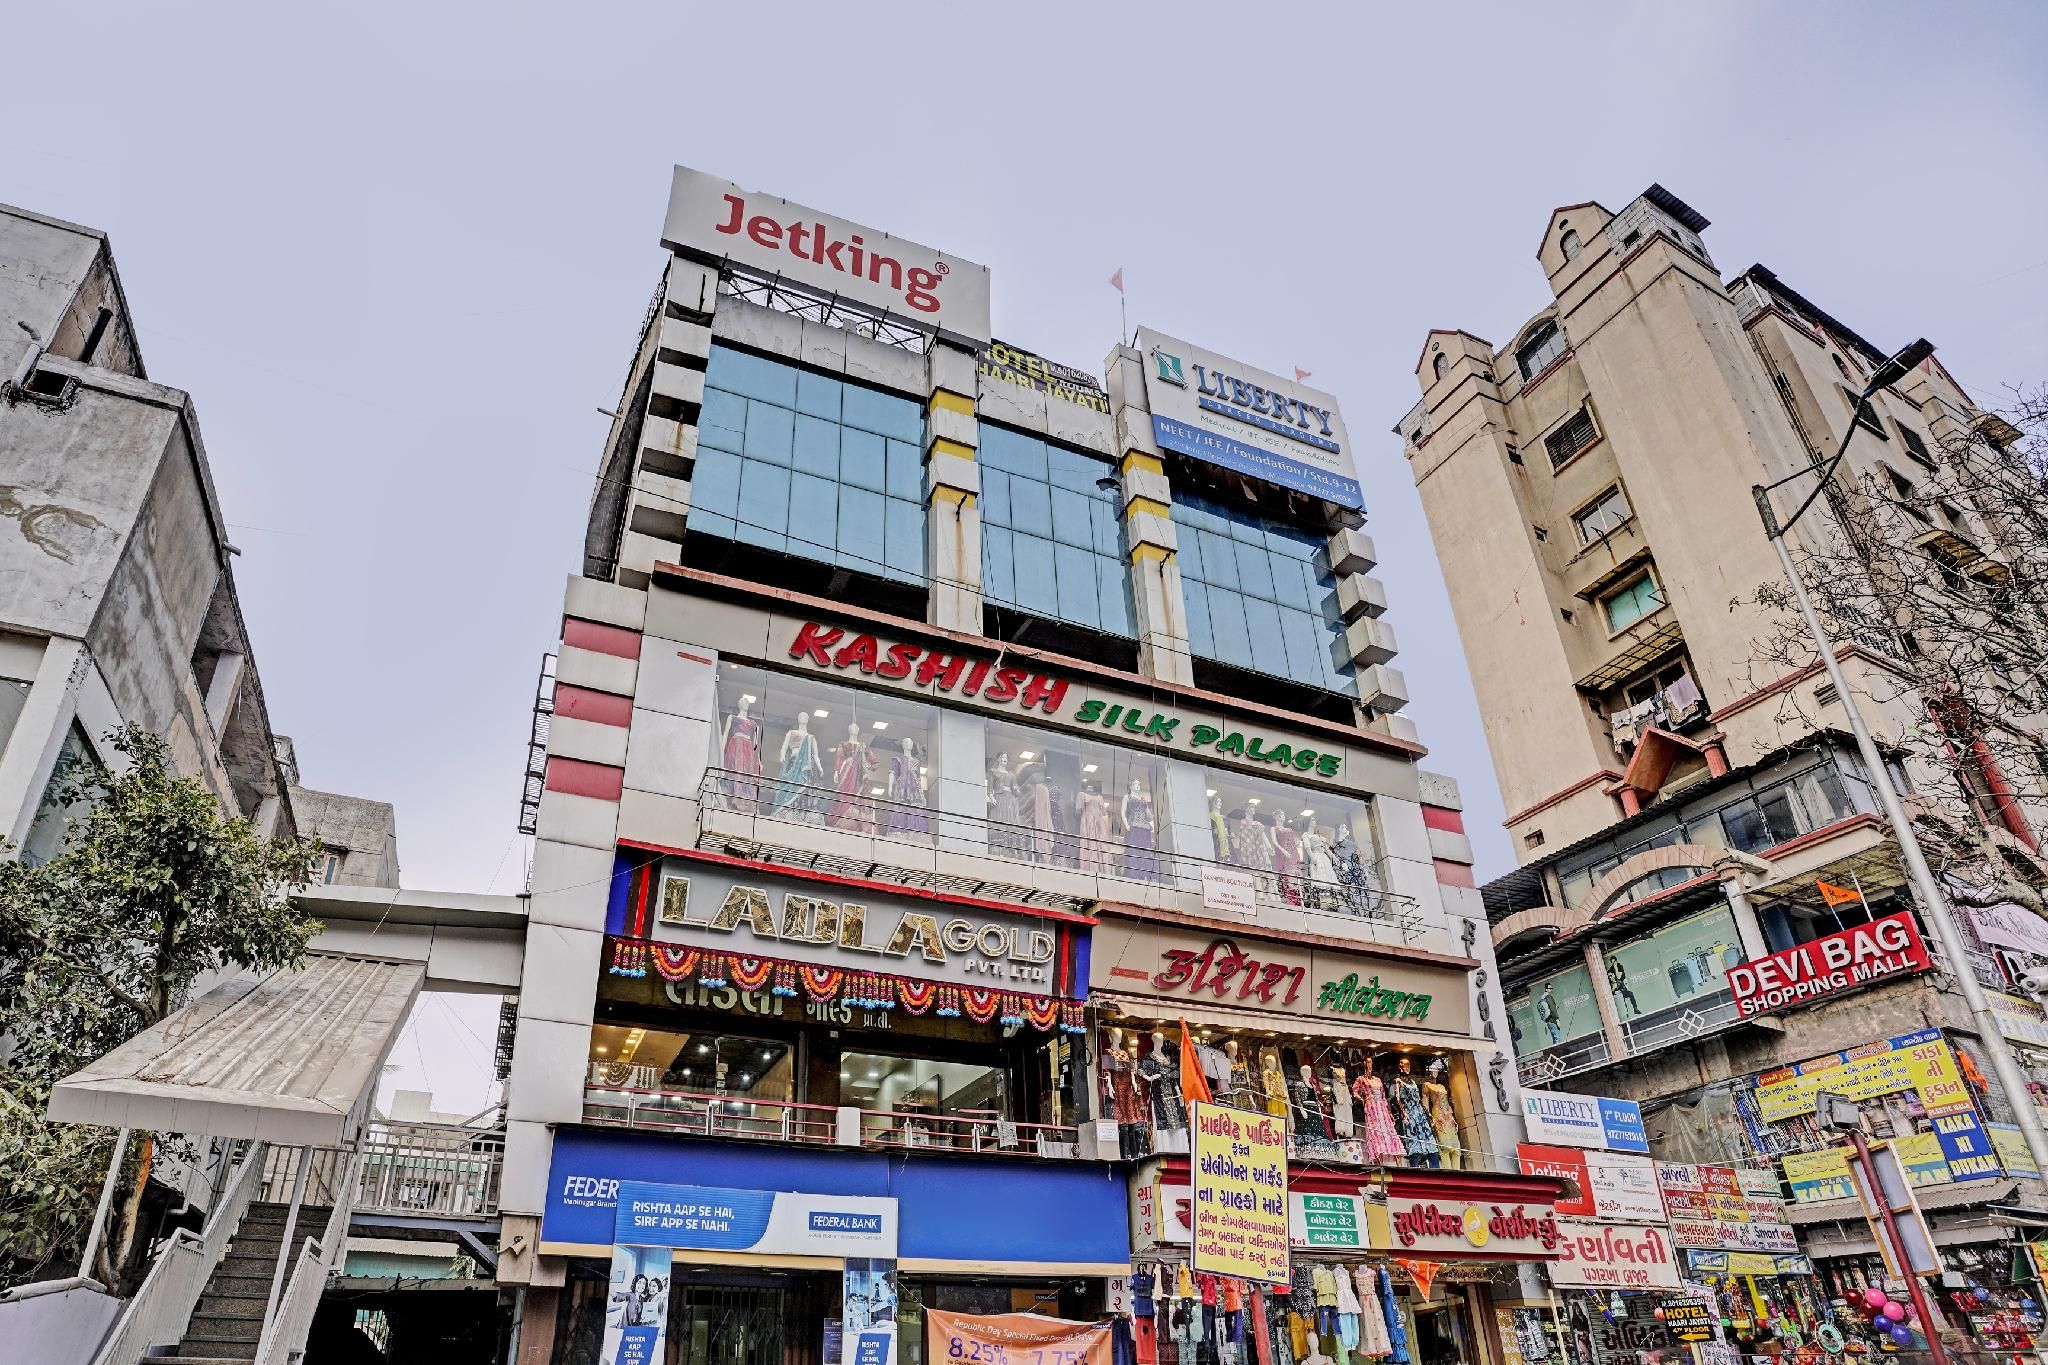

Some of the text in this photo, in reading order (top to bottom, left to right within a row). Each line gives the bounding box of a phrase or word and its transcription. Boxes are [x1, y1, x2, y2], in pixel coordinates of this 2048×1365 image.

[1192, 363, 1334, 437] LIBERTY
[1160, 421, 1193, 440] NEET
[1204, 436, 1223, 451] JEE
[1233, 446, 1301, 476] Foundation
[788, 620, 1348, 778] KASHISH SILK PALACE
[658, 874, 1056, 963] LADLA GOLD
[1730, 918, 1911, 999] DEVI BAG
[963, 959, 1046, 983] PVT. LTD.
[1740, 951, 1919, 1016] SHOPPING MALL
[1538, 1097, 1593, 1120] LIBERTY
[1614, 1111, 1637, 1124] FLOOR
[1935, 1113, 1976, 1135] KAKA
[1954, 1135, 1975, 1154] NI
[1950, 1153, 2000, 1176] DUKAN
[632, 1201, 735, 1220] RISHTA AAP SE HAI,
[1262, 1193, 1284, 1216] માટે
[634, 1215, 731, 1232] SIRF APP SE NAHI.
[813, 1215, 878, 1230] FEDERAL BANK
[1753, 1226, 1780, 1240] Smart
[1664, 1306, 1709, 1320] HOTEL
[952, 1318, 986, 1334] Republic
[987, 1324, 1002, 1338] Day
[1003, 1328, 1028, 1341] Special
[1029, 1333, 1049, 1342] Fixed
[948, 1337, 1008, 1365] 8.25%
